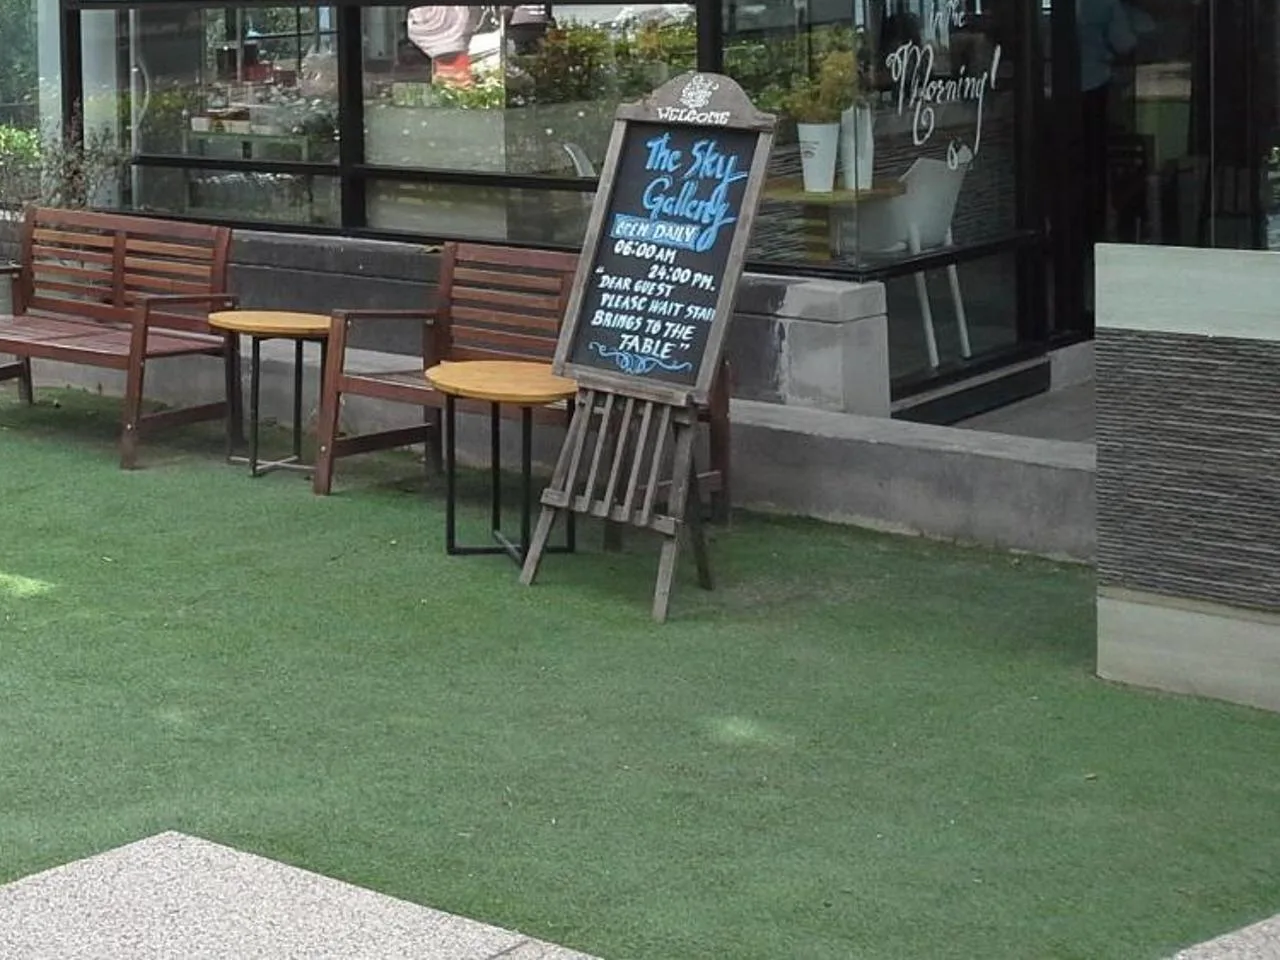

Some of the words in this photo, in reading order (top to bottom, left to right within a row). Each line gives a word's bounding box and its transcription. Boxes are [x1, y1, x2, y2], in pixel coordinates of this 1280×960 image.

[657, 107, 731, 125] WELCOME
[645, 132, 683, 172] The
[682, 139, 748, 197] Sky
[642, 176, 737, 253] Gallery
[615, 222, 650, 238] OPEN
[652, 224, 697, 243] DAILY
[648, 264, 692, 283] 24:00
[634, 280, 675, 297] GUEST
[648, 299, 684, 316] WAIT
[591, 309, 643, 331] BRINGS
[645, 318, 662, 335] TO
[662, 321, 696, 340] THE
